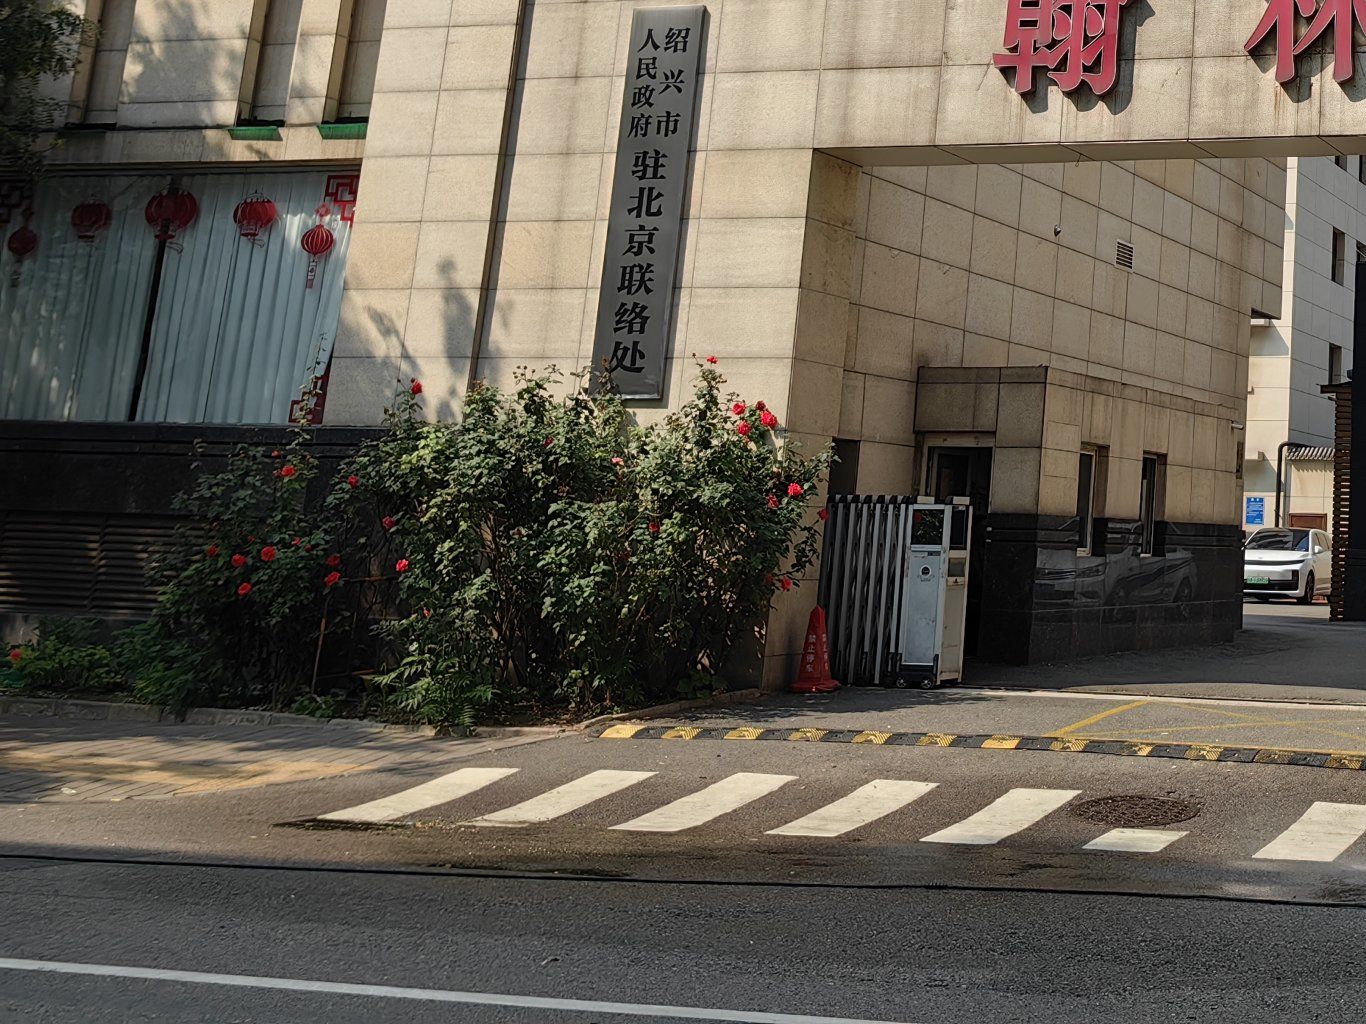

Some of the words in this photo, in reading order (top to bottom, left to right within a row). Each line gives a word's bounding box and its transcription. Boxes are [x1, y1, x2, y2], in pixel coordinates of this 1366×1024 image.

[627, 27, 661, 139] 人民政府
[656, 26, 691, 138] 绍兴市
[609, 148, 669, 375] 驻北京联络处
